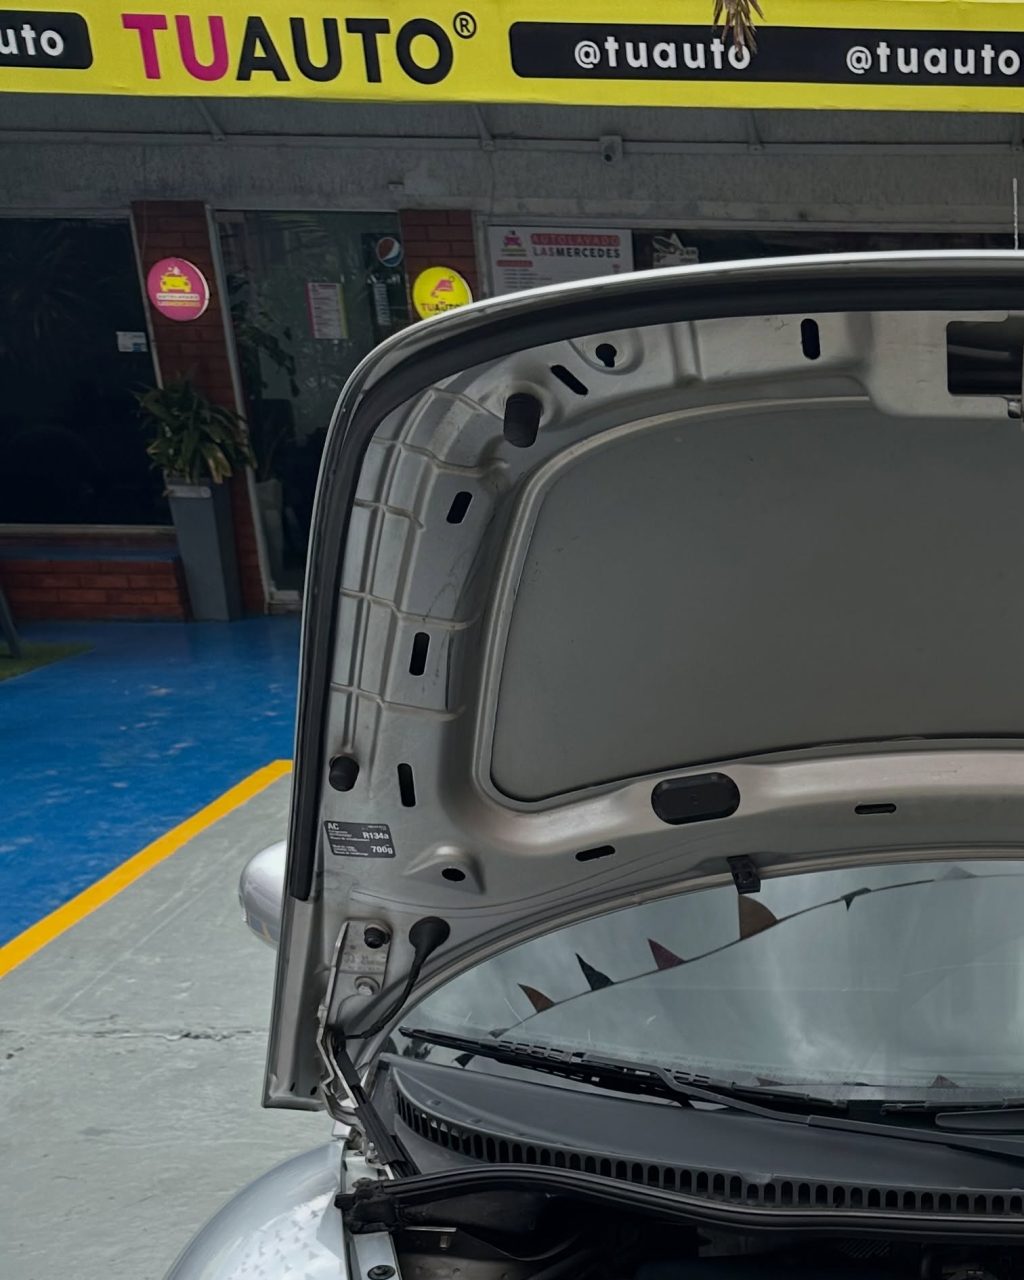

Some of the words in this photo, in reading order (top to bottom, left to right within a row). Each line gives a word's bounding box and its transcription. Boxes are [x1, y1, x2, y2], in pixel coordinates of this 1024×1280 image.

[574, 36, 750, 70] @tuauto
[846, 42, 1020, 75] @tuauto
[533, 247, 621, 259] LASMERCEDES
[362, 831, 389, 840] R134a
[370, 845, 394, 854] 700g
